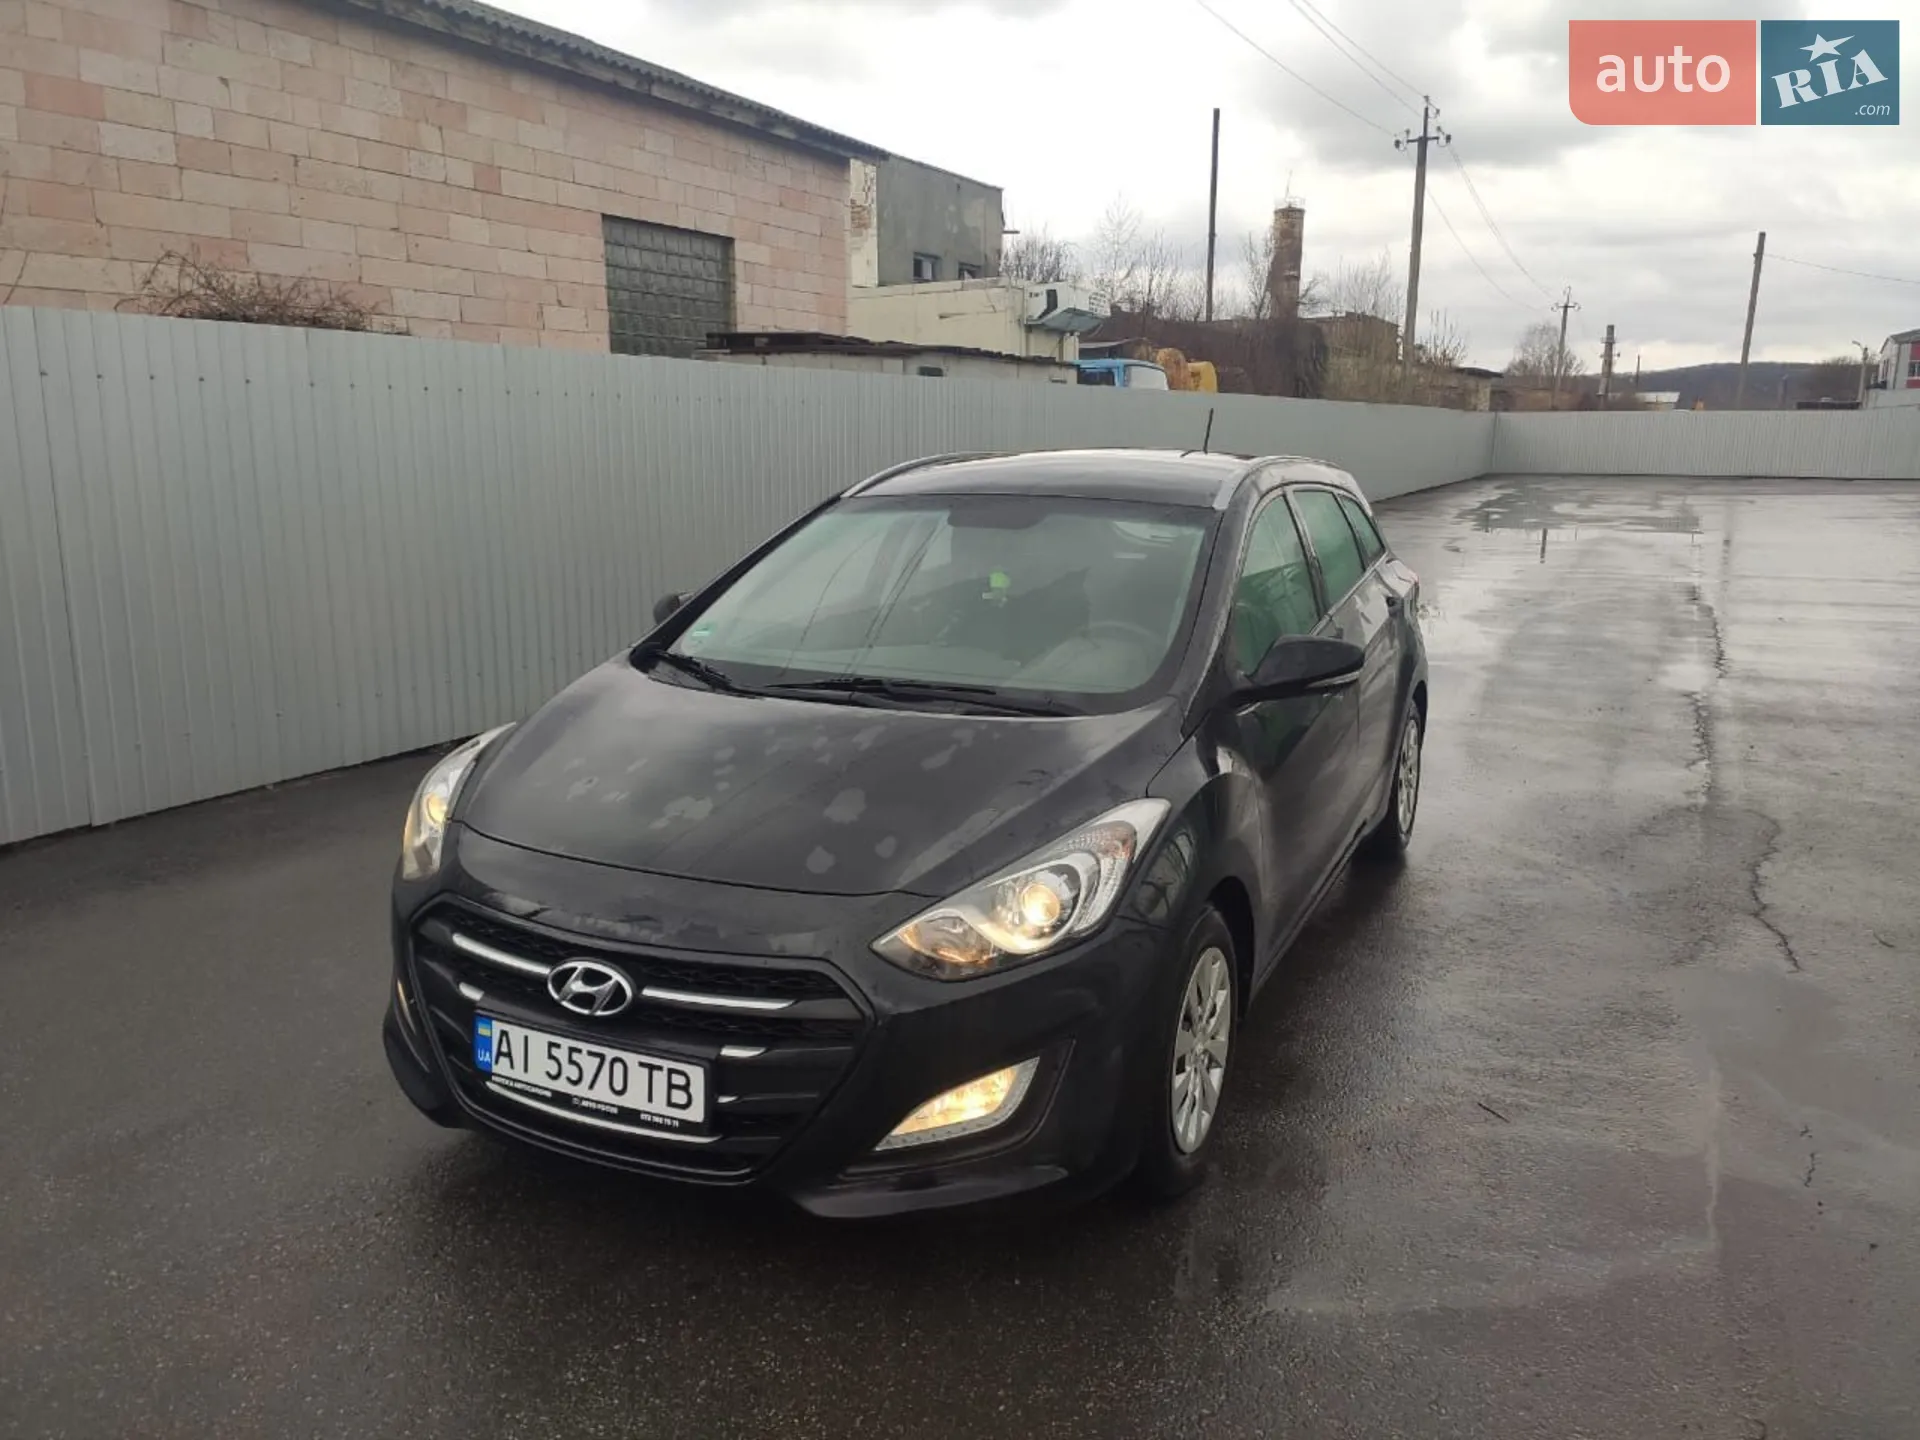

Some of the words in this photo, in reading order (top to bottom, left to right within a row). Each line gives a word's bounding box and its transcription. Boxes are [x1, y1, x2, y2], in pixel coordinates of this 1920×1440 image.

[477, 1048, 491, 1062] UA
[494, 1029, 529, 1074] AI
[545, 1040, 628, 1097] 5570
[638, 1061, 694, 1111] TB
